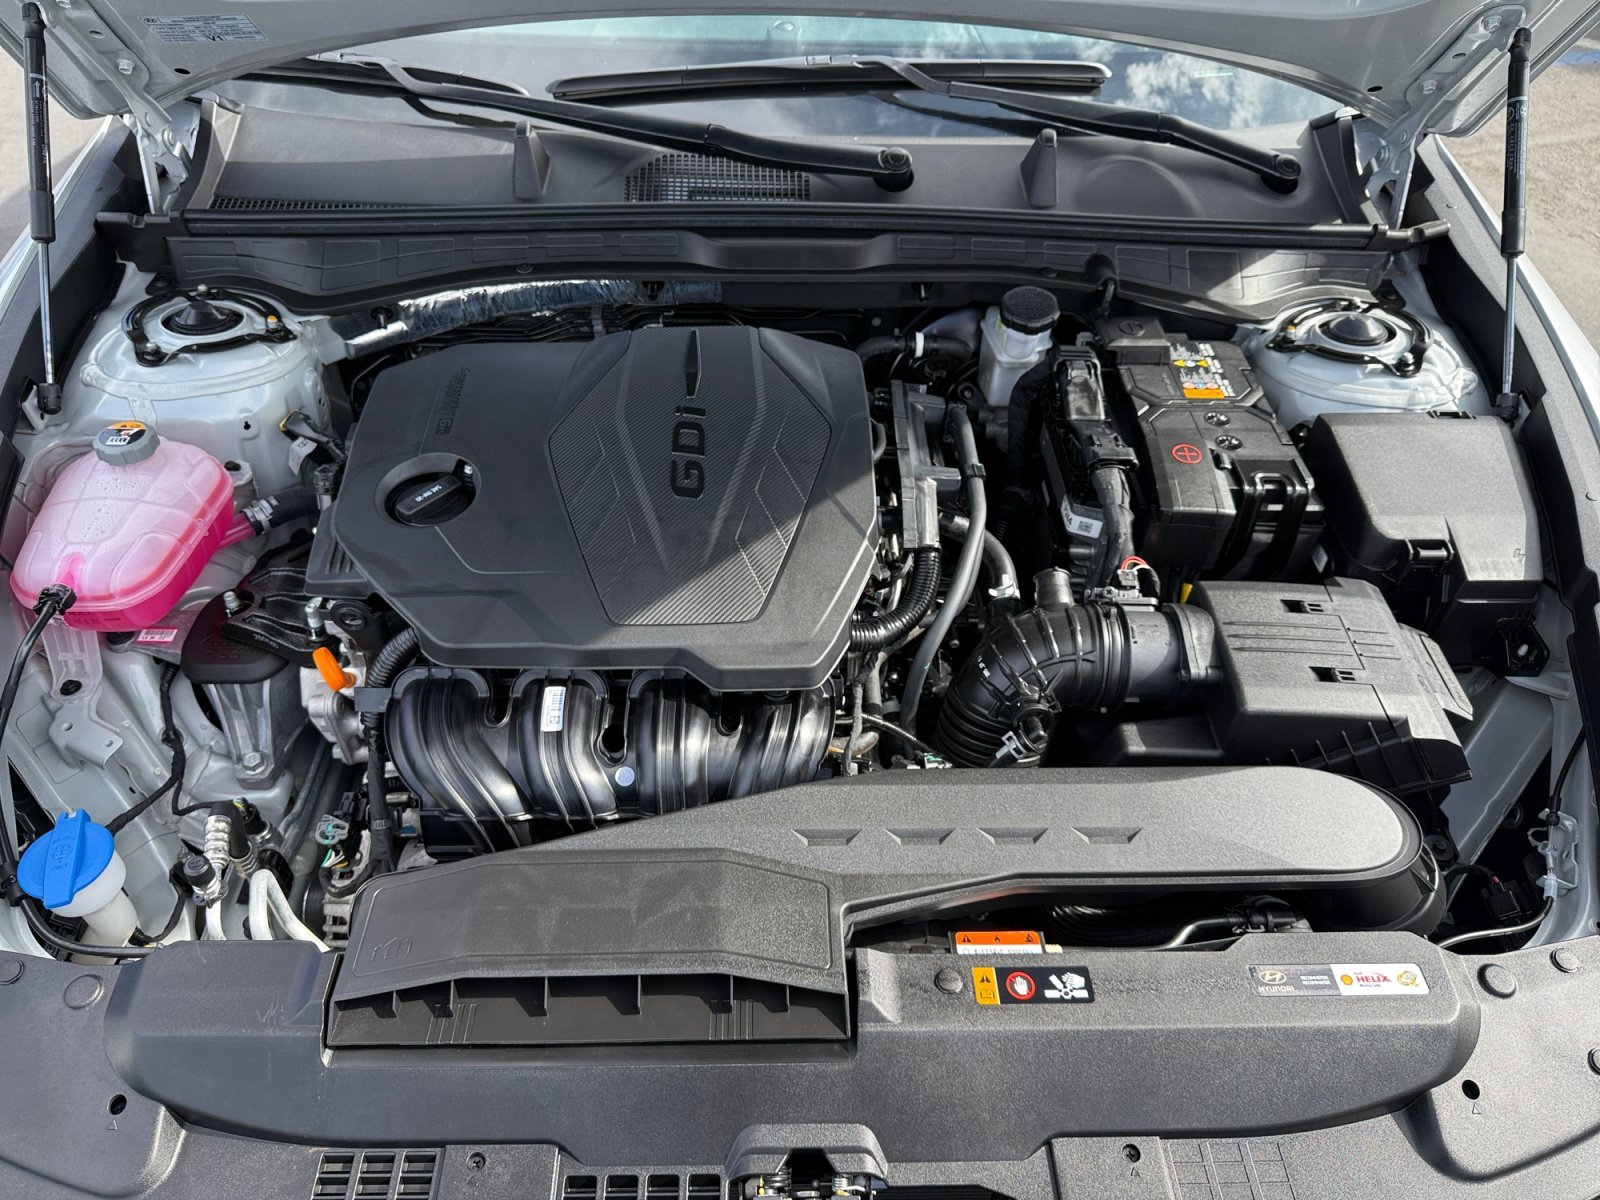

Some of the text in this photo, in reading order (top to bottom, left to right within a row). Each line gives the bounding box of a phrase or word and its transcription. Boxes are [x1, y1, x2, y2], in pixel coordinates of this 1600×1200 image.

[671, 405, 706, 500] GDi
[1356, 975, 1391, 983] HELIX
[1258, 985, 1295, 993] HYUNDAI
